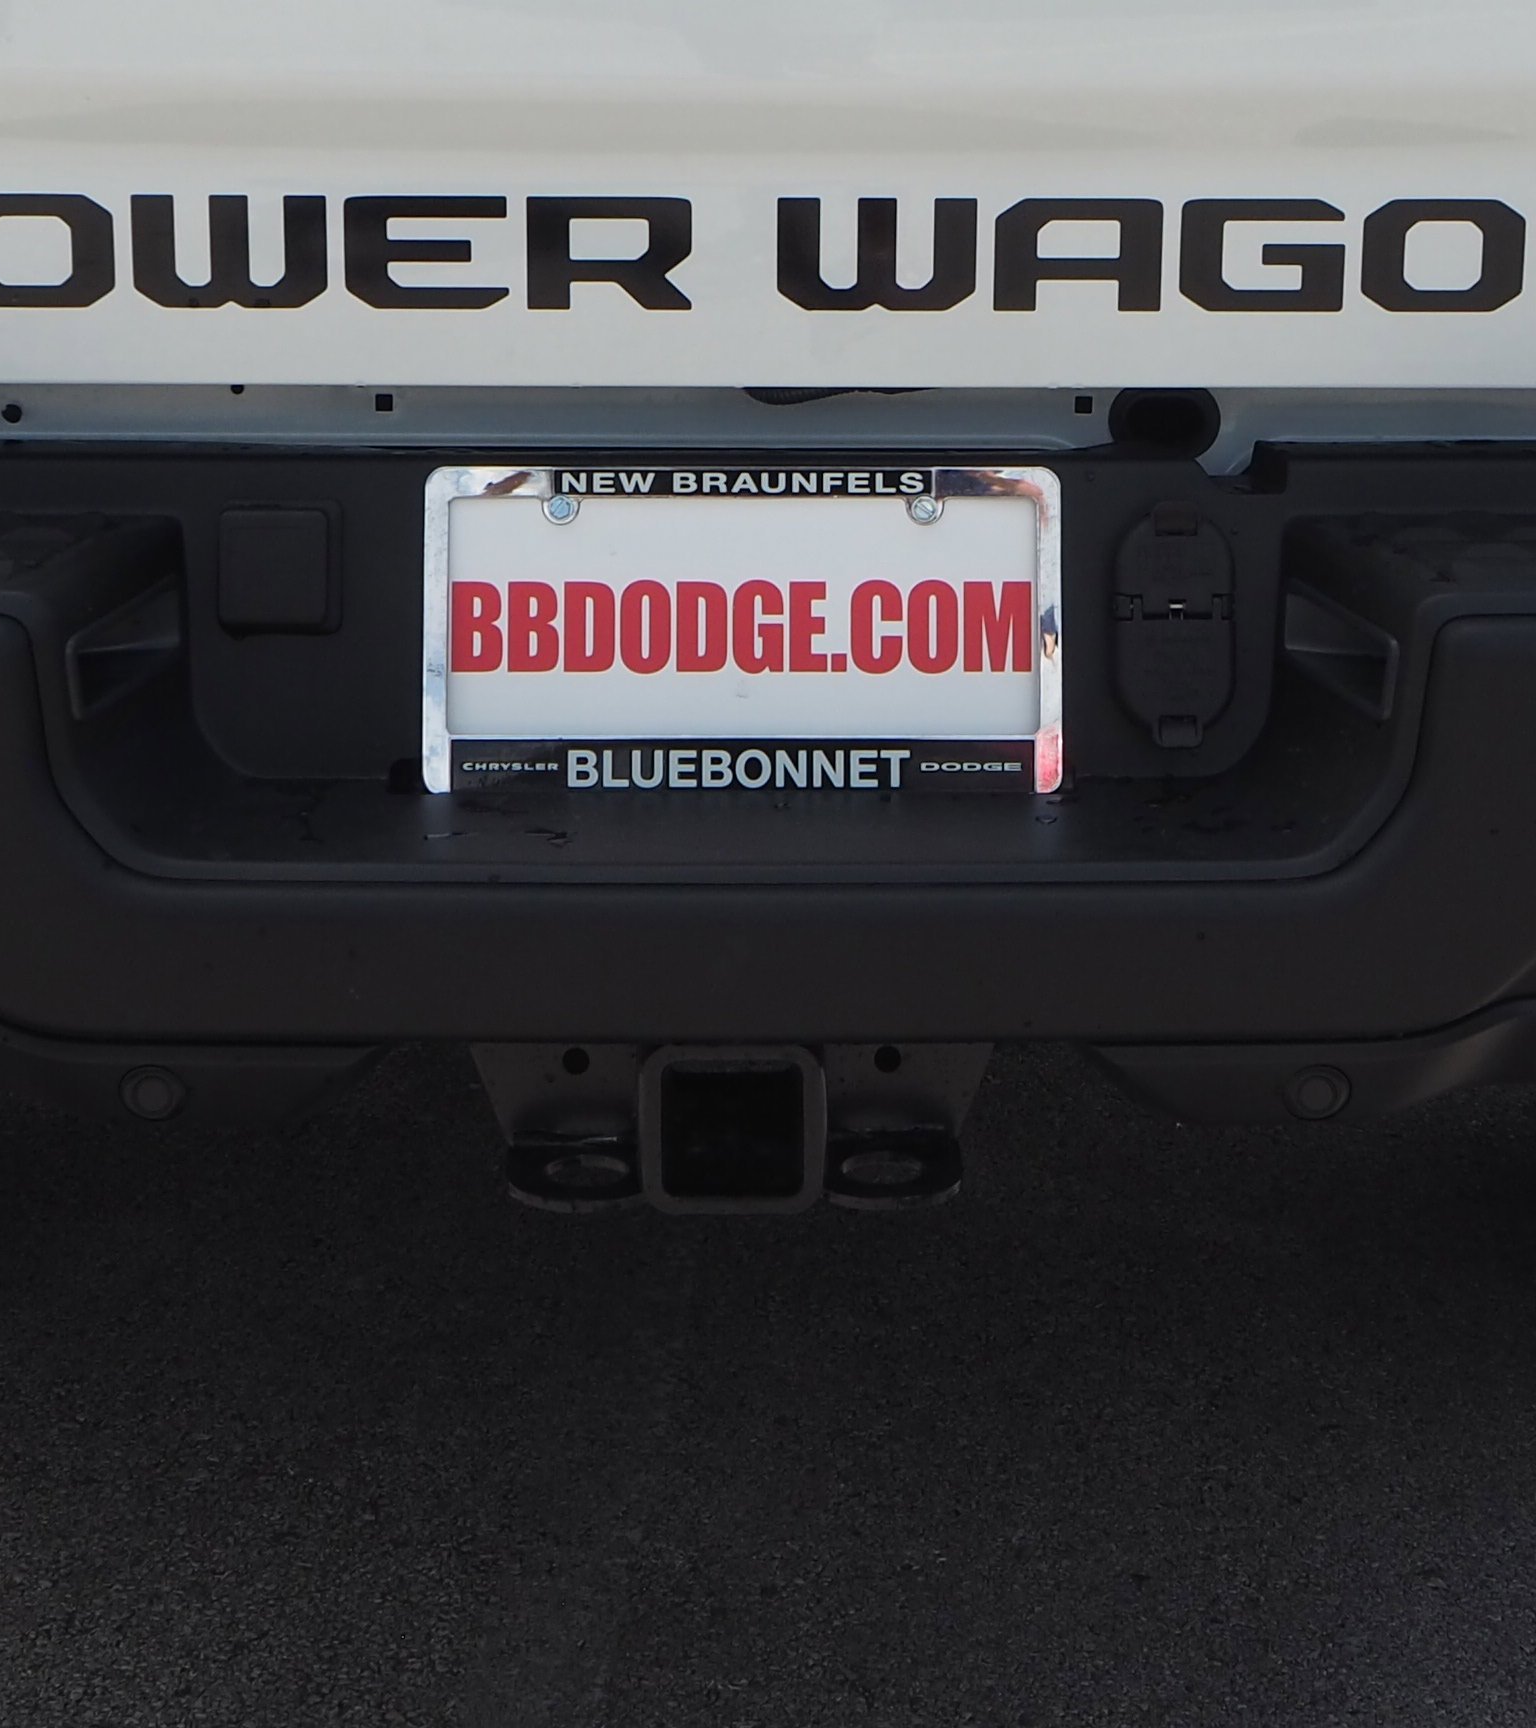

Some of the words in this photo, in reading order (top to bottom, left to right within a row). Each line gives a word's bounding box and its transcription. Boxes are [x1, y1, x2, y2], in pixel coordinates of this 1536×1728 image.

[561, 472, 655, 494] NEW
[672, 472, 925, 494] BRAUNFELS
[451, 580, 1032, 674] BBDODGE.COM
[462, 761, 559, 772] CHRYSLER
[566, 748, 911, 789] BLUEBONNET
[920, 761, 1023, 773] DODGE
